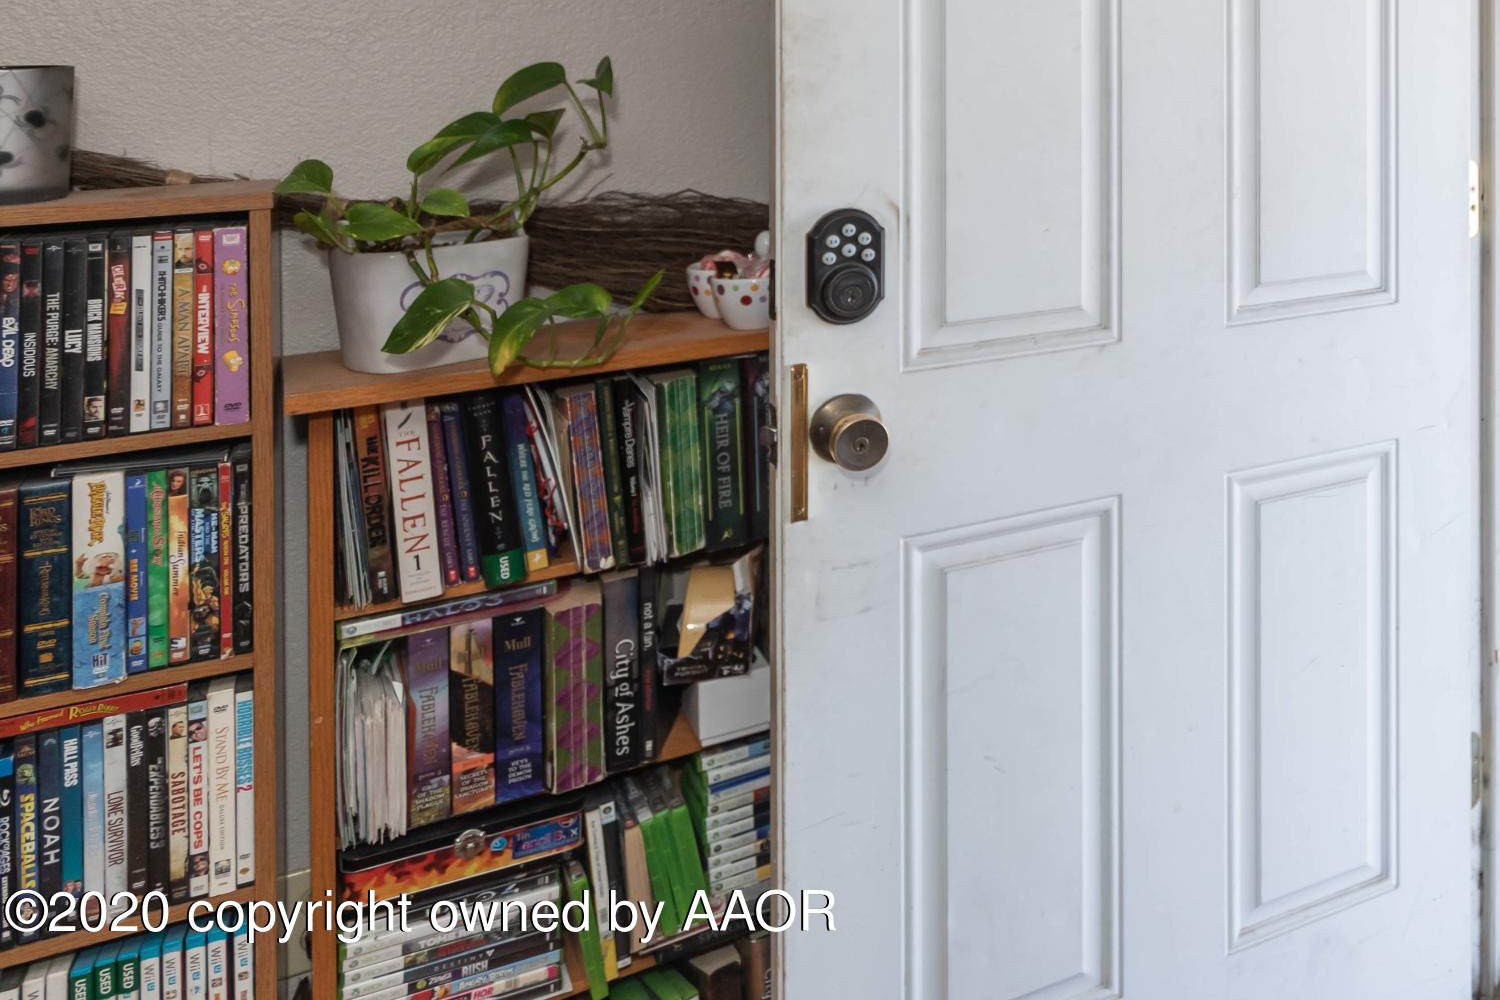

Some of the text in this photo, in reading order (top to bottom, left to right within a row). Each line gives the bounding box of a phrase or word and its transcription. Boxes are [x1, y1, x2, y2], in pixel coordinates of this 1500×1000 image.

[0, 317, 19, 368] EVIL DEAD
[44, 292, 60, 390] THE PURGE: ANARCHY
[64, 329, 82, 353] LUCY
[86, 298, 103, 362] BRICK MANSIONS
[157, 322, 165, 340] GUIDE
[157, 344, 165, 352] TO
[176, 288, 191, 376] A MAN APART
[197, 293, 210, 354] INTERVIEW
[23, 332, 37, 378] INSIDIOUS
[156, 368, 165, 392] GALAXY
[157, 353, 165, 367] THE
[360, 455, 382, 493] KILL
[481, 435, 503, 523] FALLEN
[715, 412, 733, 509] HEIR OF FIRE
[365, 493, 387, 548] ORDER
[396, 436, 430, 554] FALLEN
[413, 554, 421, 571] 1
[195, 508, 206, 562] MASTERS
[210, 512, 218, 554] HE-MAN
[238, 502, 250, 593] PREDATORS
[130, 574, 138, 600] MOVIE
[170, 531, 187, 596] Indian Summer
[499, 555, 510, 580] USED
[403, 599, 487, 625] HALO
[643, 602, 655, 620] not
[643, 622, 651, 630] a
[504, 636, 532, 651] Mull
[610, 638, 636, 757] City of Ashes
[63, 738, 78, 788] HALL PASS
[214, 726, 230, 764] STAND
[236, 700, 253, 793] HORRIBLE BOSSES 2
[192, 746, 203, 850] LET'S BE COPS
[215, 765, 230, 782] BY
[215, 783, 230, 803] ME
[149, 764, 165, 838] EXPENDABLES
[171, 771, 186, 836] SABOTAGE
[0, 816, 11, 874] ROCK AGES
[19, 793, 36, 889] SPACEBALLS
[43, 796, 61, 866] NOAH
[107, 790, 124, 867] LONE SURVIVOR
[100, 967, 112, 995] USED
[122, 962, 134, 989] USED
[462, 960, 489, 977] RUSH
